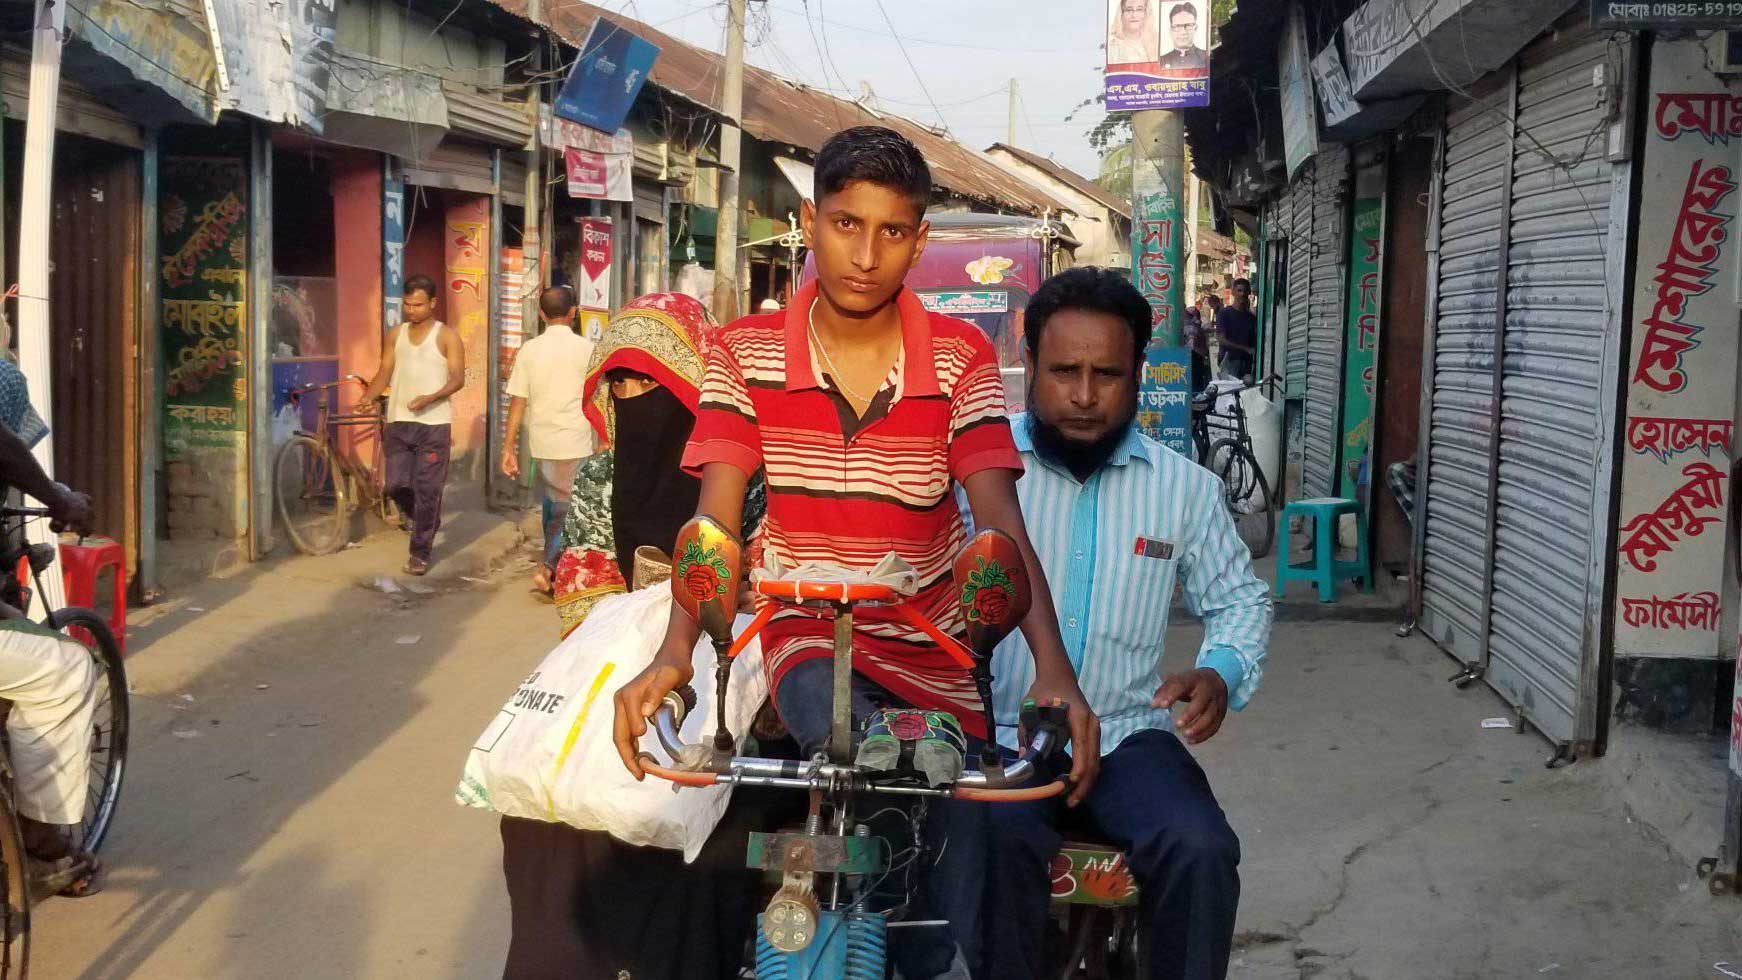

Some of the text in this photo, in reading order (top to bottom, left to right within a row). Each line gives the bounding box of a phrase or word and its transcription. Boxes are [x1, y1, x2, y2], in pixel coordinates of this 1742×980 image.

[1628, 416, 1733, 460] হোসেন
[1619, 462, 1728, 572] মৌসুমী
[1622, 591, 1722, 630] ফার্মেসী
